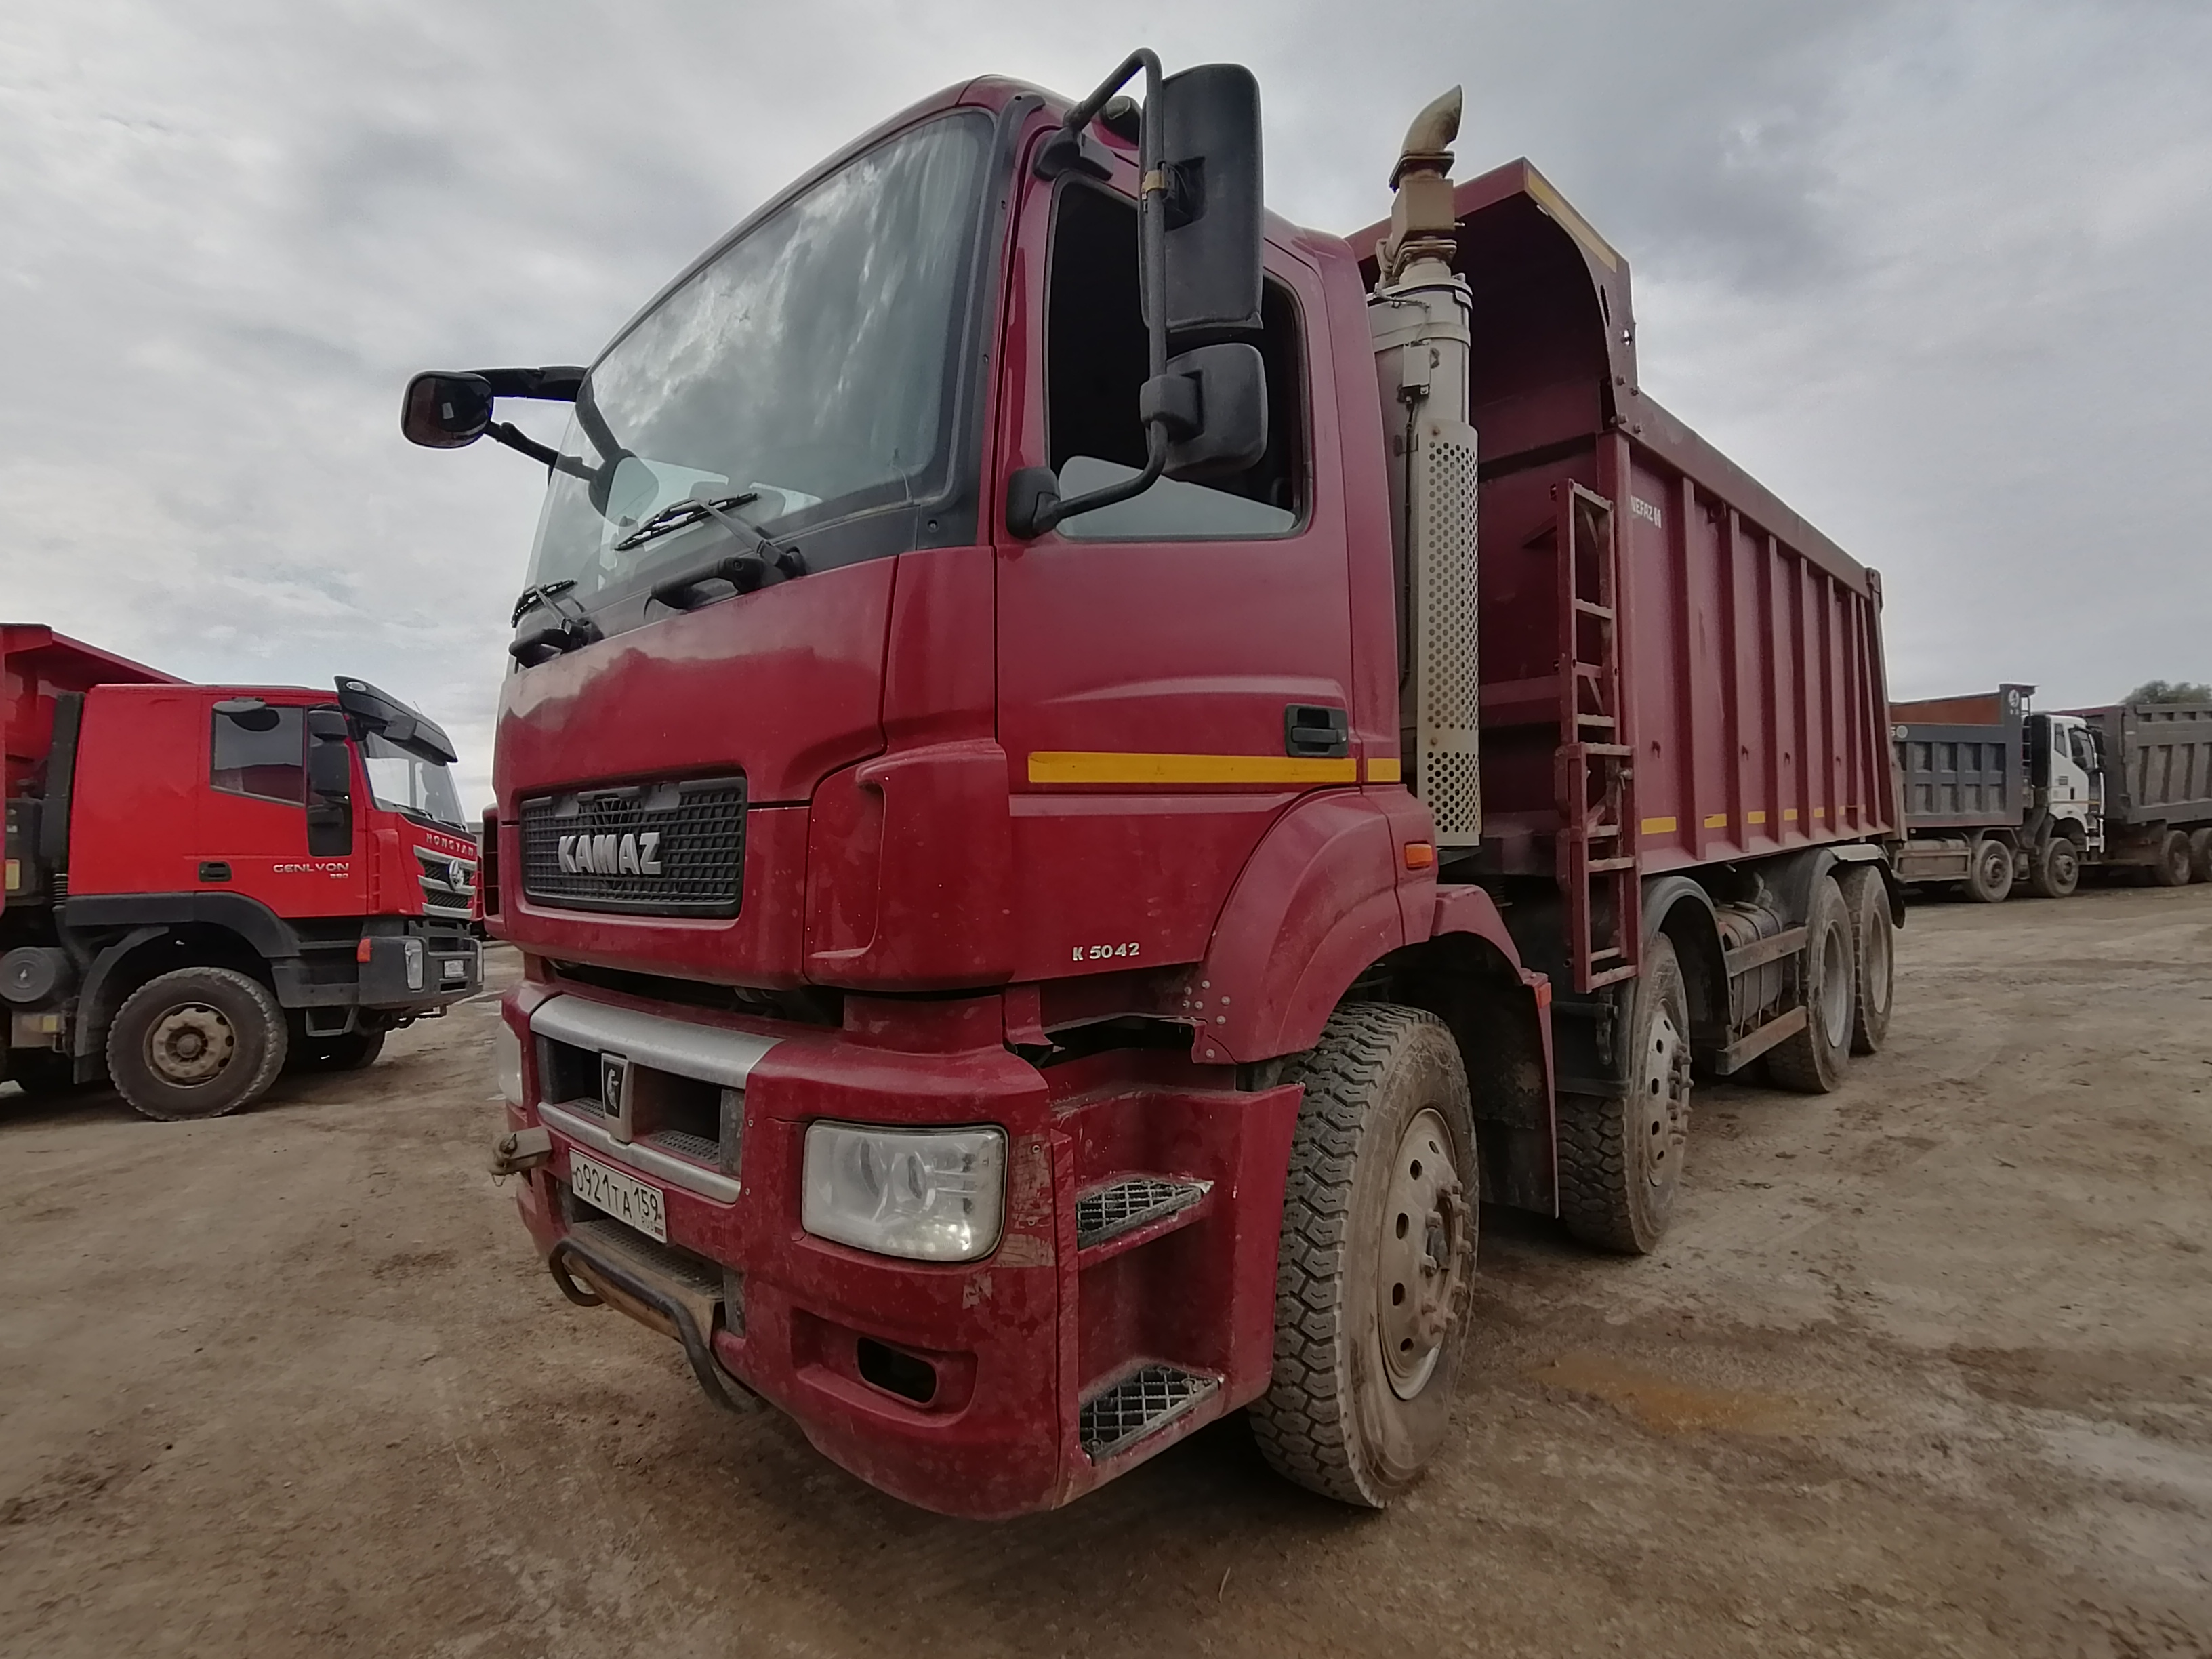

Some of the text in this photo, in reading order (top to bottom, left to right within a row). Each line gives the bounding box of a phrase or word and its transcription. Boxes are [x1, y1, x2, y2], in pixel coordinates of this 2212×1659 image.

[558, 832, 661, 874] KAMAZ
[1073, 942, 1139, 961] K 5042
